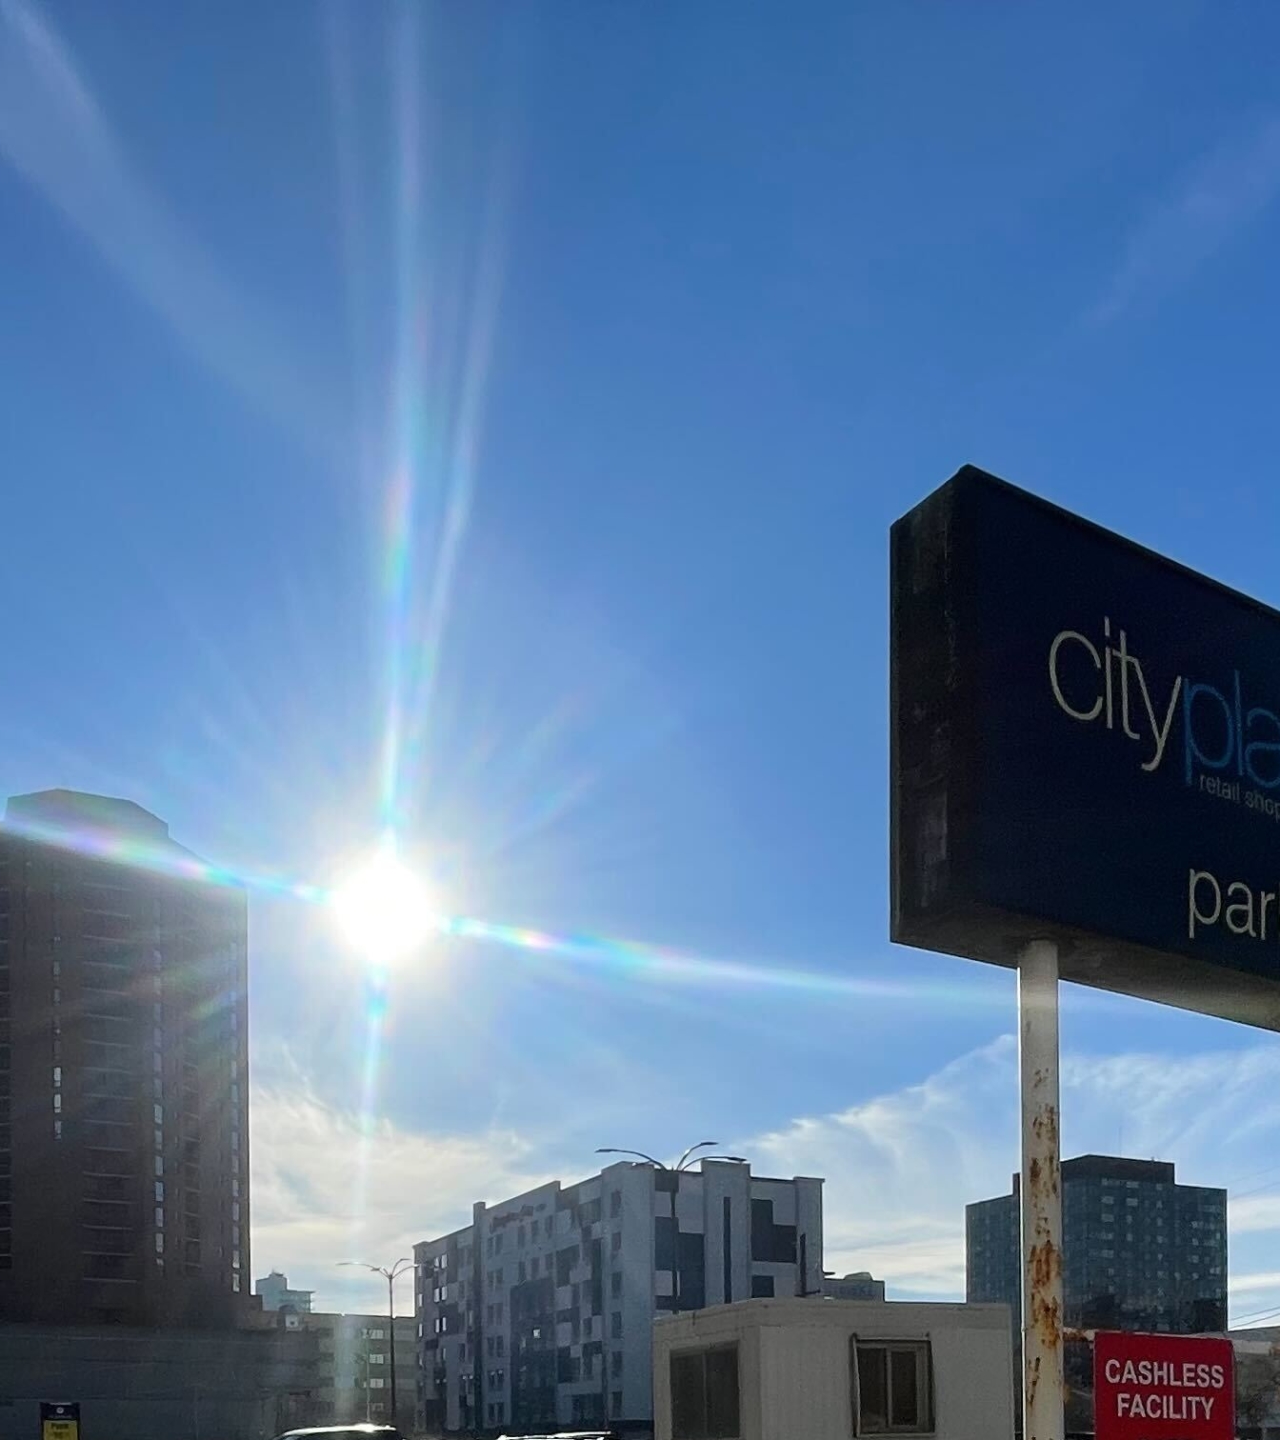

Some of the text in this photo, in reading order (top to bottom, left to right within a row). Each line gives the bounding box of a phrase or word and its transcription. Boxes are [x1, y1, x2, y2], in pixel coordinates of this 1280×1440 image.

[1199, 773, 1241, 802] retail
[1105, 1358, 1224, 1389] CASHLESS
[1117, 1393, 1215, 1420] FACILITY
